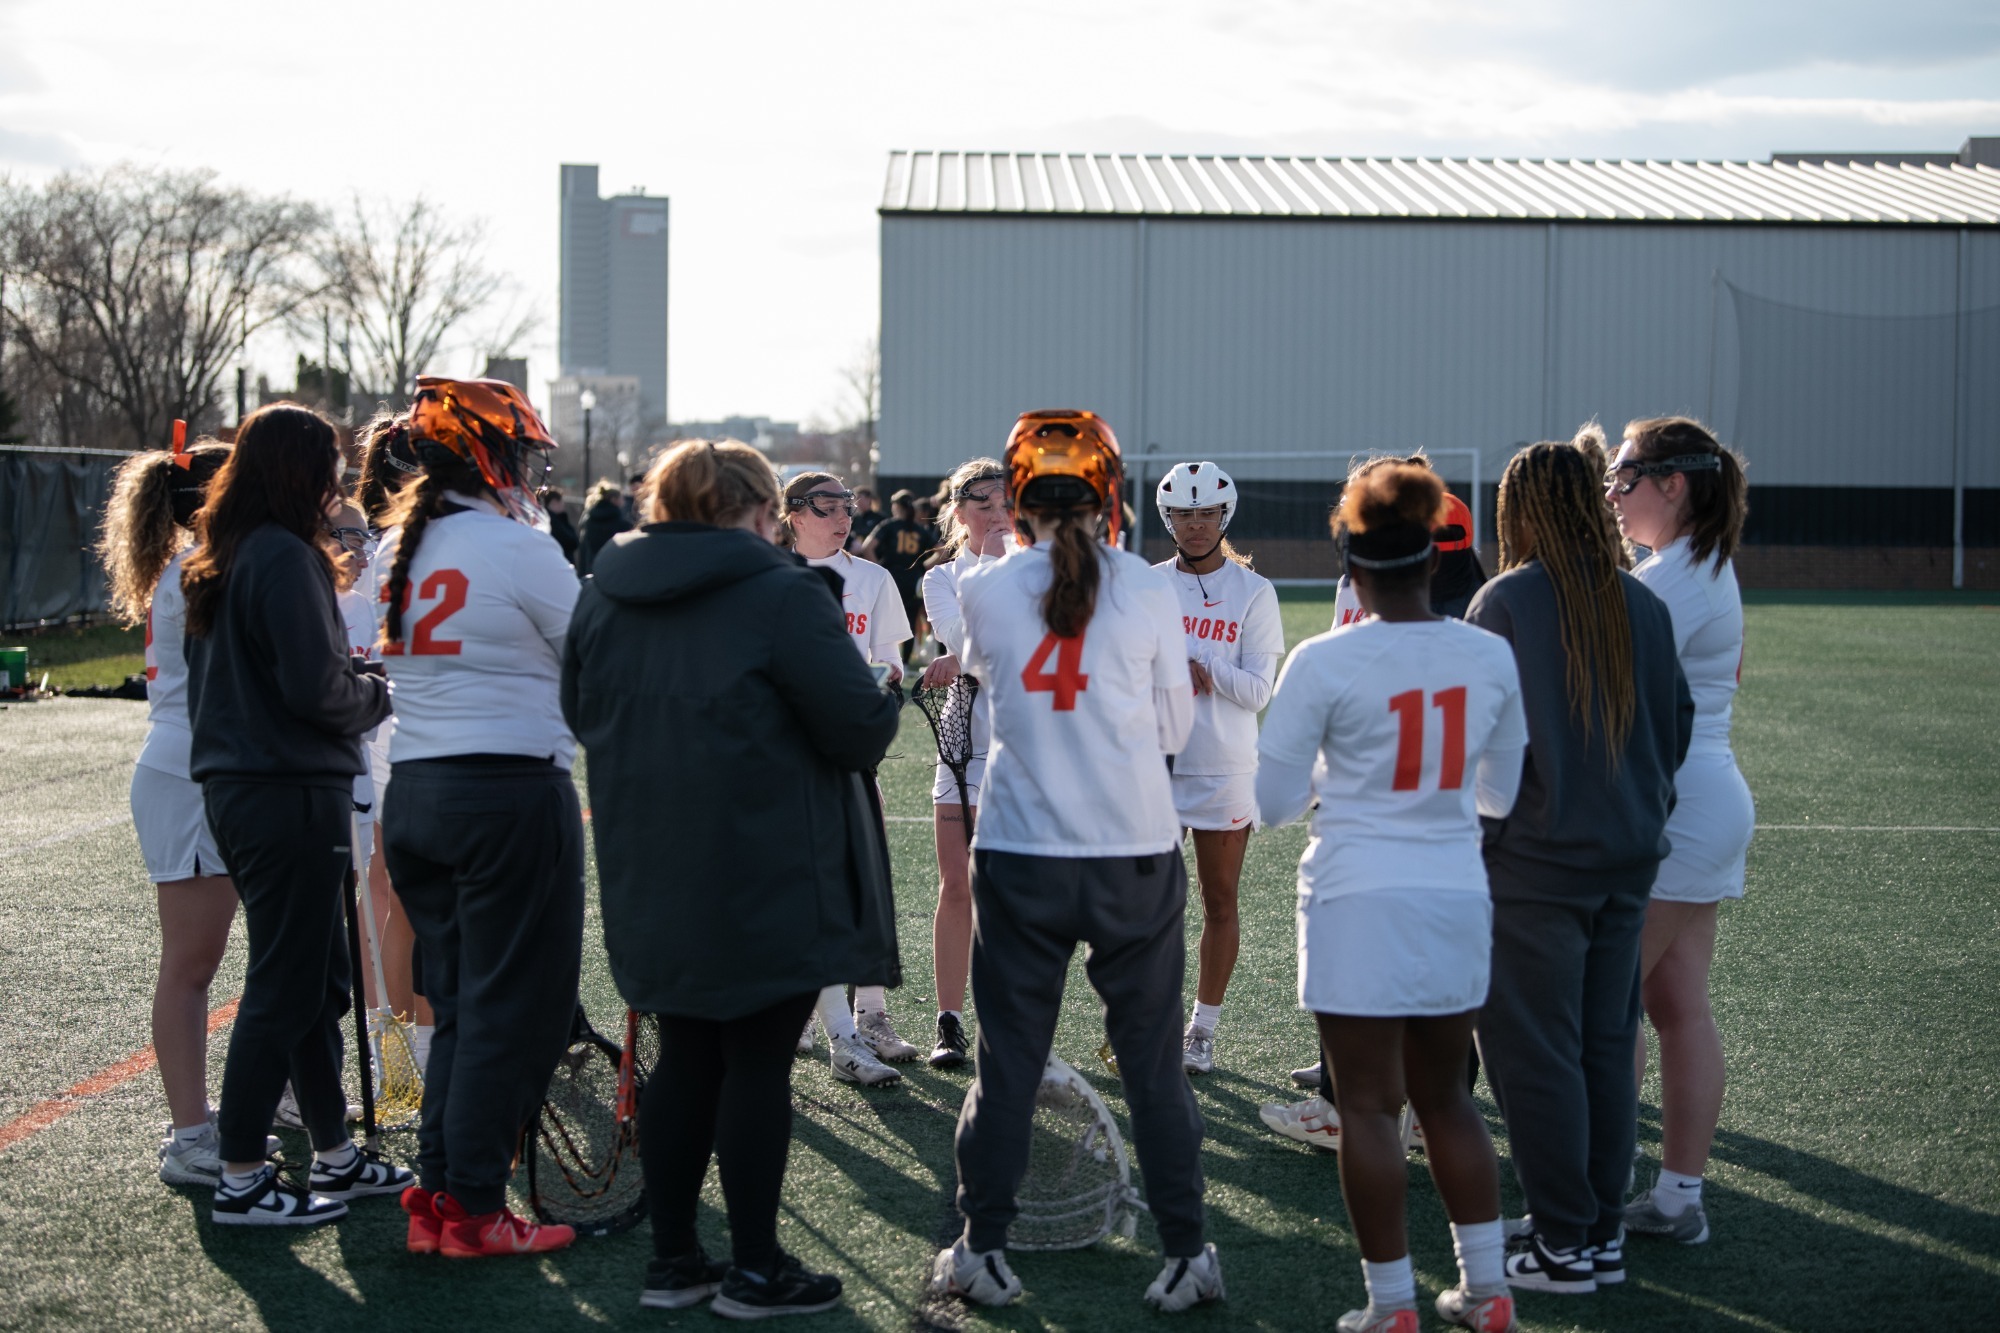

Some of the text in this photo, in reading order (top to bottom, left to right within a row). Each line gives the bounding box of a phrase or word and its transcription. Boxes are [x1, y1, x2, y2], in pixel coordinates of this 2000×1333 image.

[396, 460, 412, 471] STX
[897, 530, 919, 554] 16
[1021, 627, 1089, 711] 4
[1388, 685, 1467, 792] 11
